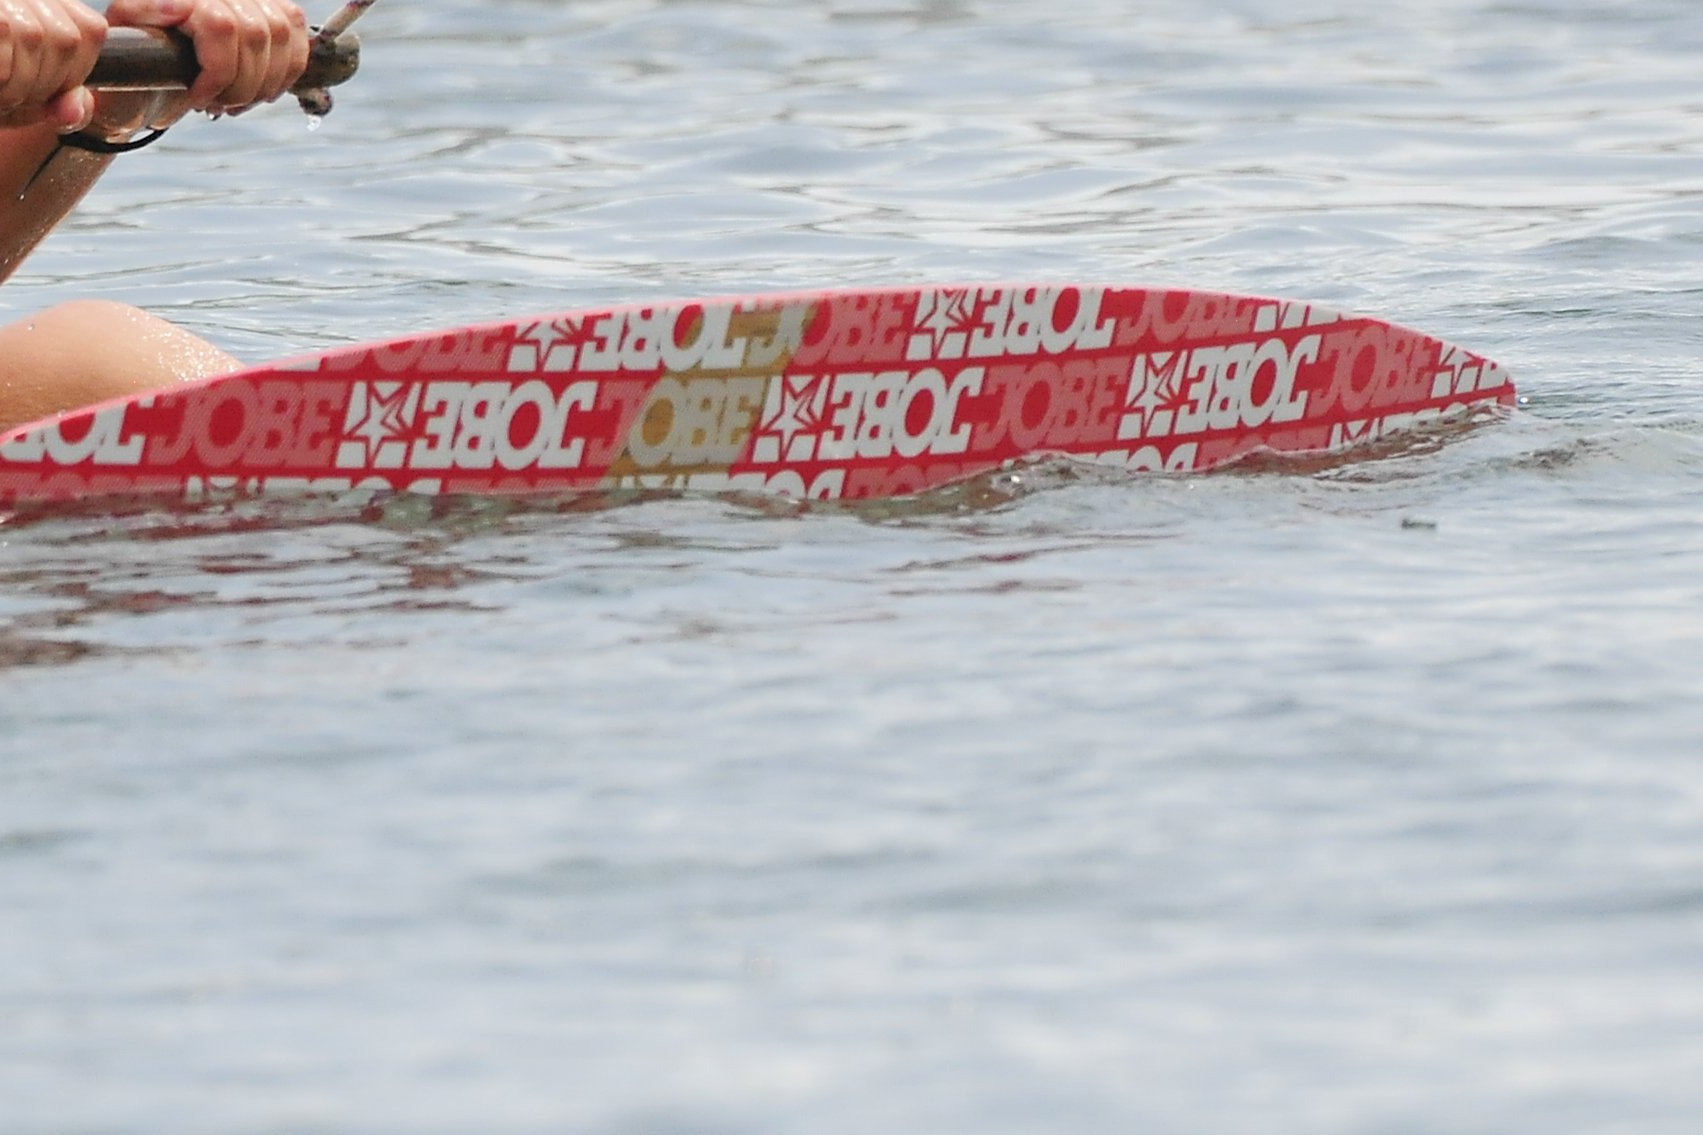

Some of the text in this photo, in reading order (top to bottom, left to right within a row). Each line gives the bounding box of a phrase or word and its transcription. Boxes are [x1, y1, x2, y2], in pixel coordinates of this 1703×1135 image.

[147, 378, 349, 468] JOBE
[408, 379, 599, 470] JOBE
[585, 377, 766, 468] JOBE
[816, 367, 985, 461] JOBE
[972, 354, 1132, 452] JOBE
[1173, 334, 1322, 435] JOBE
[1306, 325, 1443, 418] JOBE
